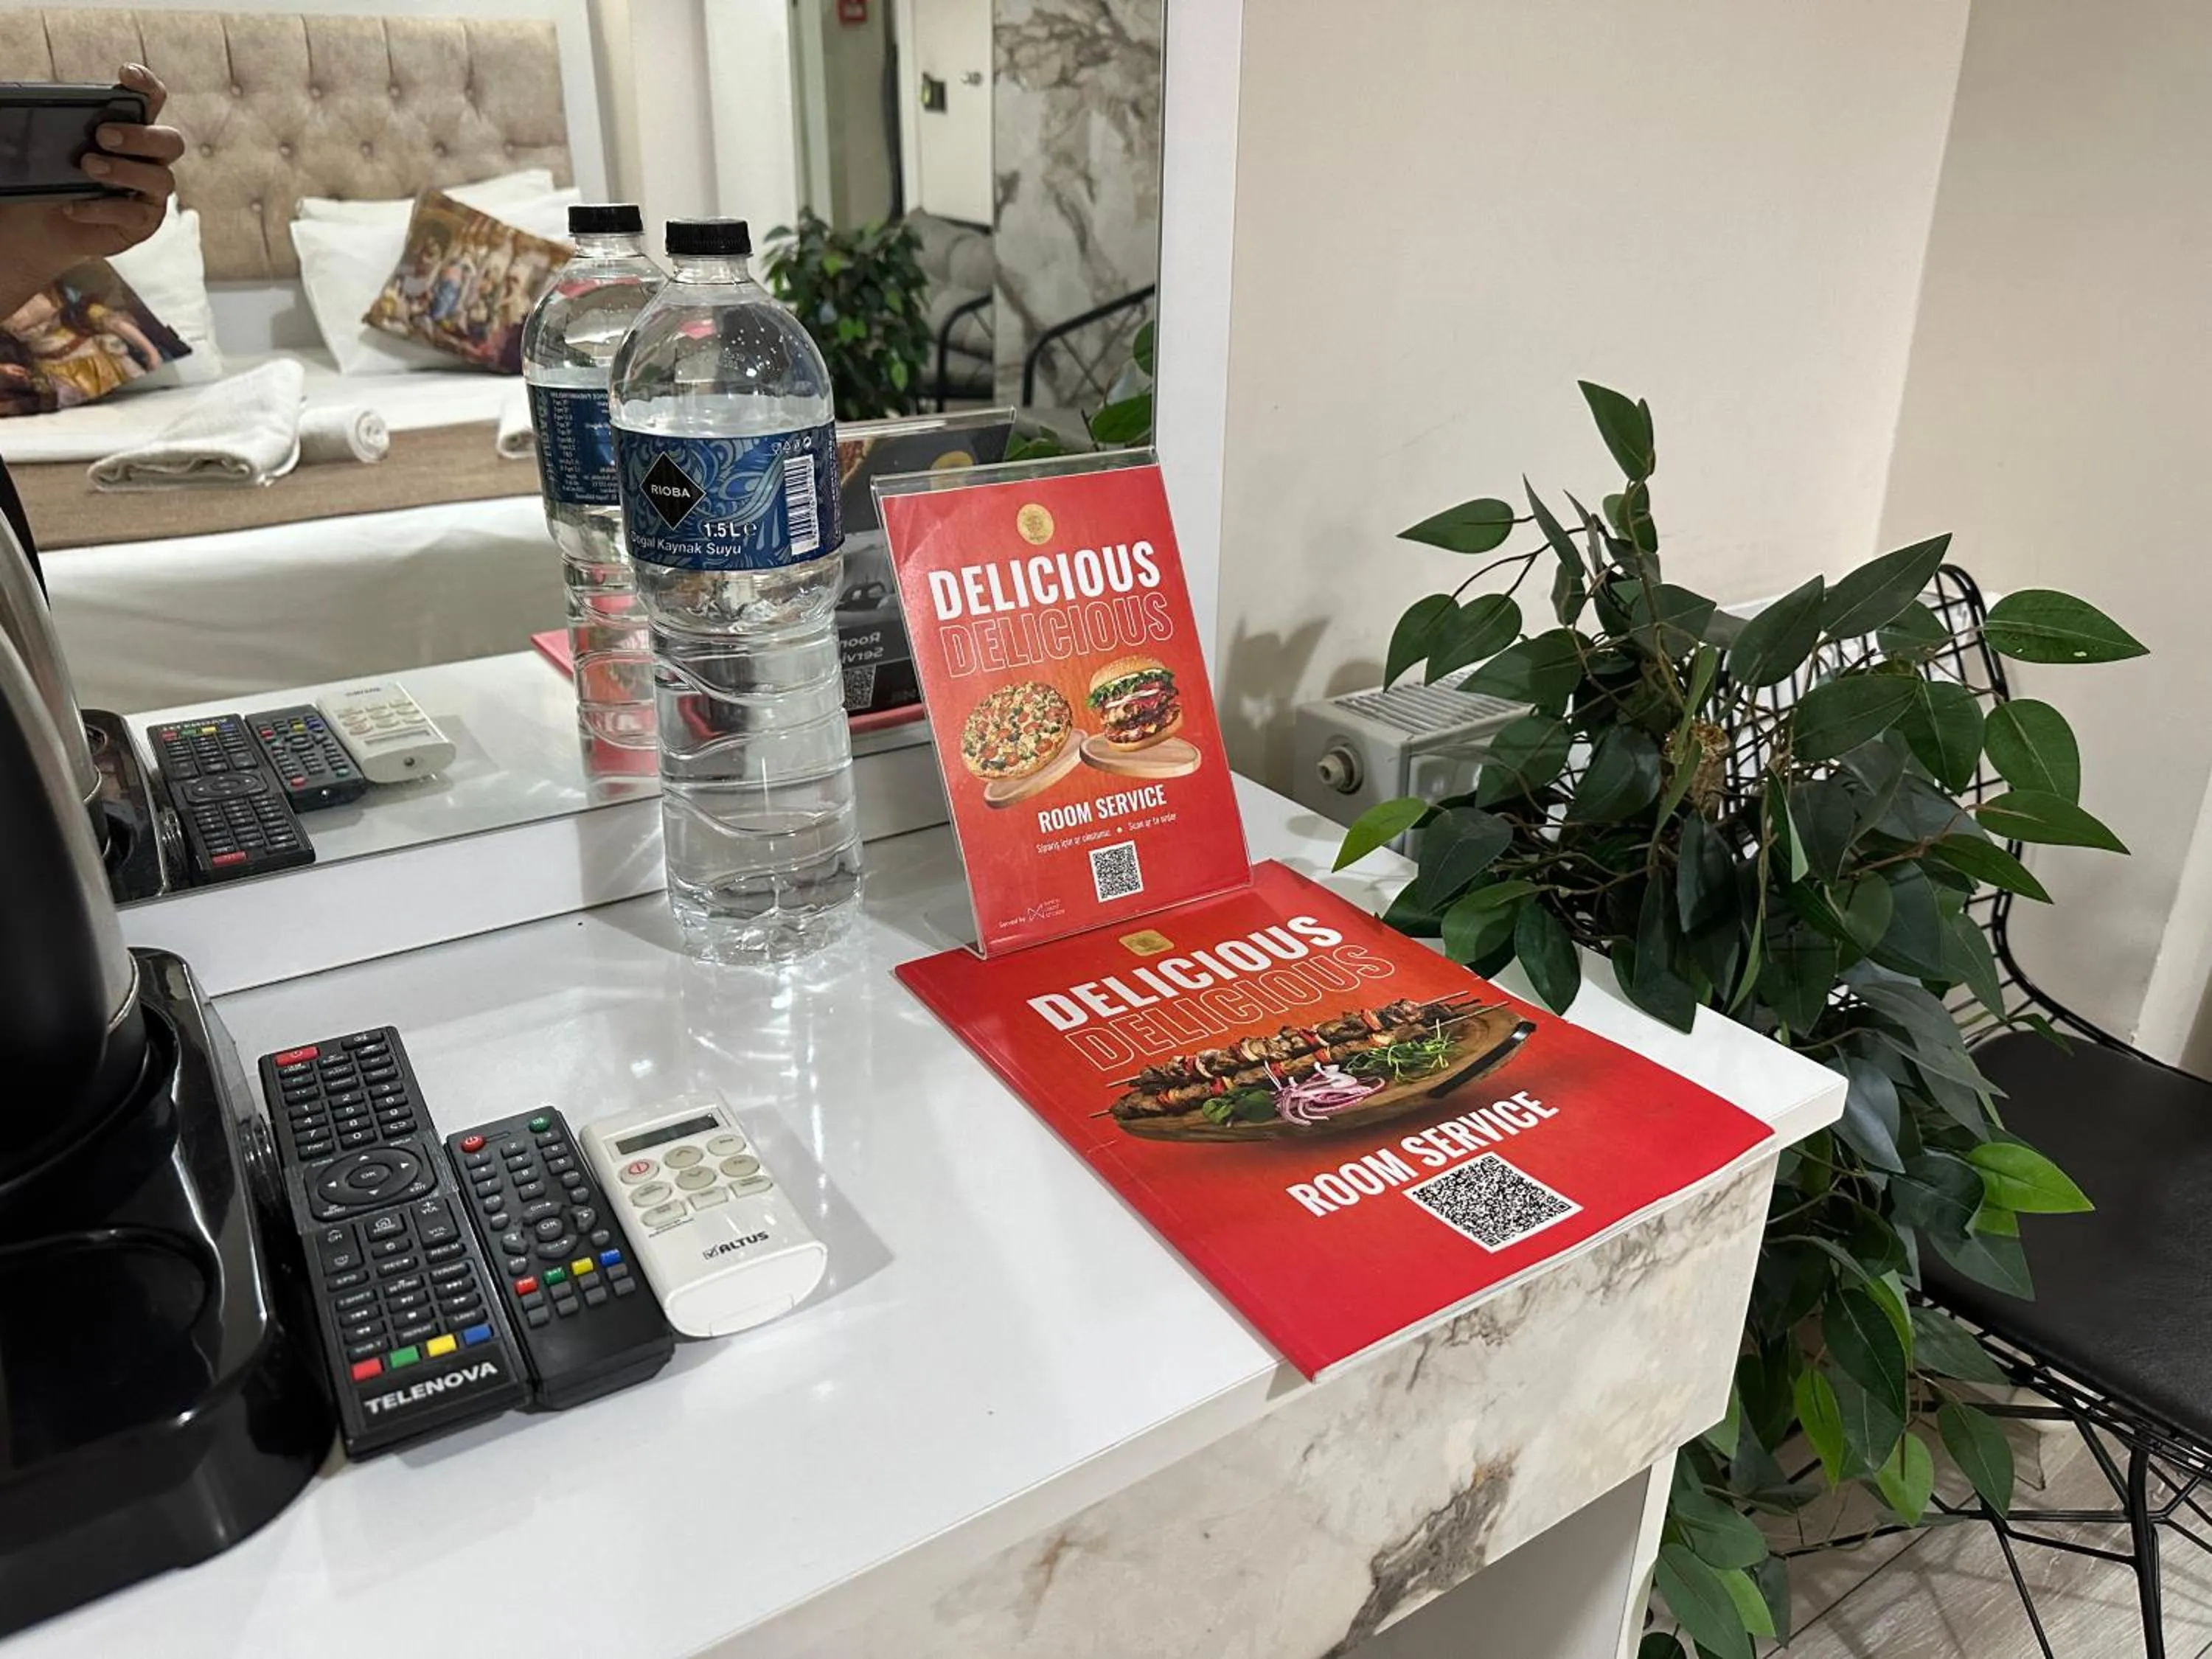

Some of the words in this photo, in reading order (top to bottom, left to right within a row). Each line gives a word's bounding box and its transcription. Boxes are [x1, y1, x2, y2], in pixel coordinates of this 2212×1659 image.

[650, 484, 691, 498] RIOBA
[657, 536, 702, 554] Kaynak
[706, 542, 741, 557] Suyu
[703, 522, 727, 538] 1.5
[928, 540, 1161, 620] DELICIOUS
[939, 591, 1174, 678] DELICIOUS
[1037, 801, 1093, 834] ROOM
[1096, 784, 1167, 819] SERVICE
[1026, 916, 1343, 1032] DELICIOUS
[1065, 945, 1395, 1071] DELICIOUS
[1286, 1147, 1419, 1217] ROOM
[1400, 1091, 1559, 1168] SERVICE
[540, 1221, 558, 1230] OK
[718, 1230, 770, 1254] ALTUS
[364, 1361, 498, 1414] TELENOVA
